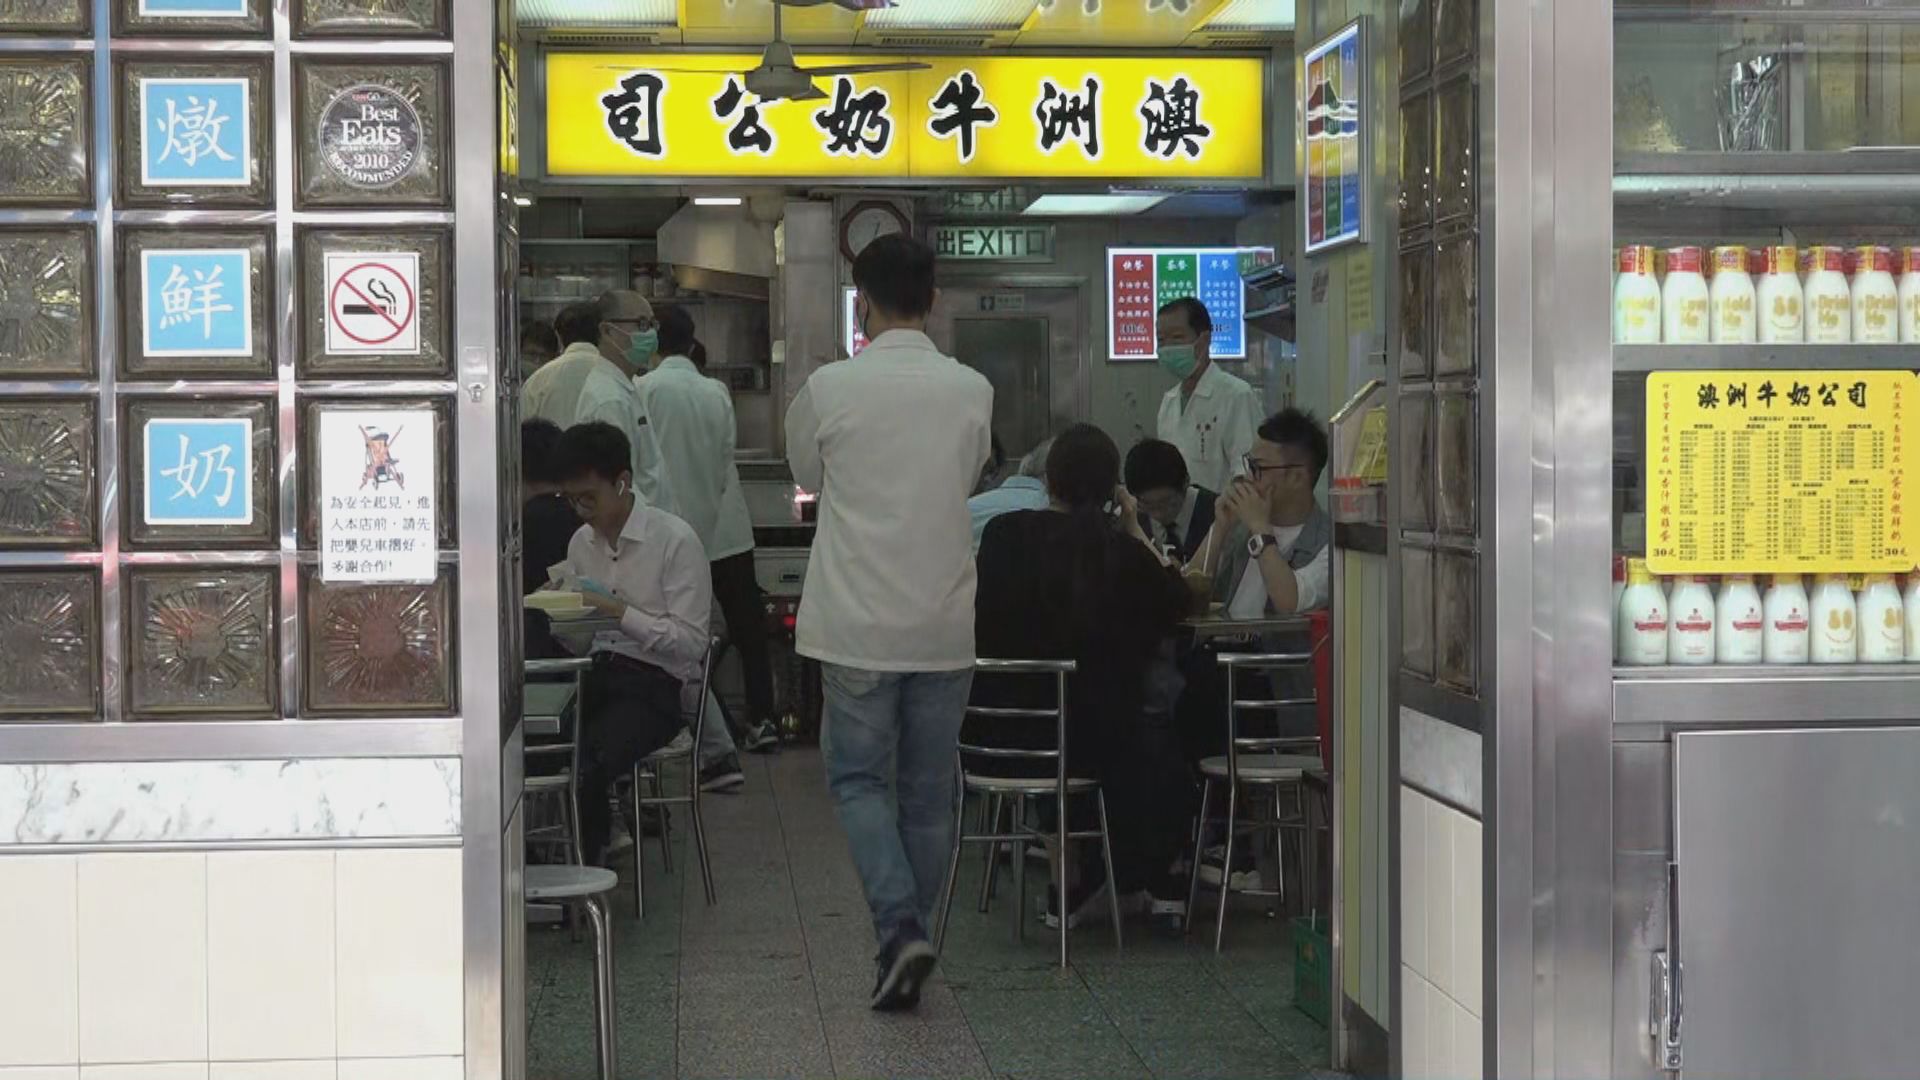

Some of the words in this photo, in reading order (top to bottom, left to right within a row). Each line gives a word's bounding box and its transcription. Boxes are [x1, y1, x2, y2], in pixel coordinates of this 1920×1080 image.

[361, 104, 399, 121] Best
[340, 119, 401, 146] Eats
[329, 150, 413, 183] RECOMMENDED
[353, 153, 389, 169] 2010
[1696, 380, 1868, 409] 澳洲牛奶公司
